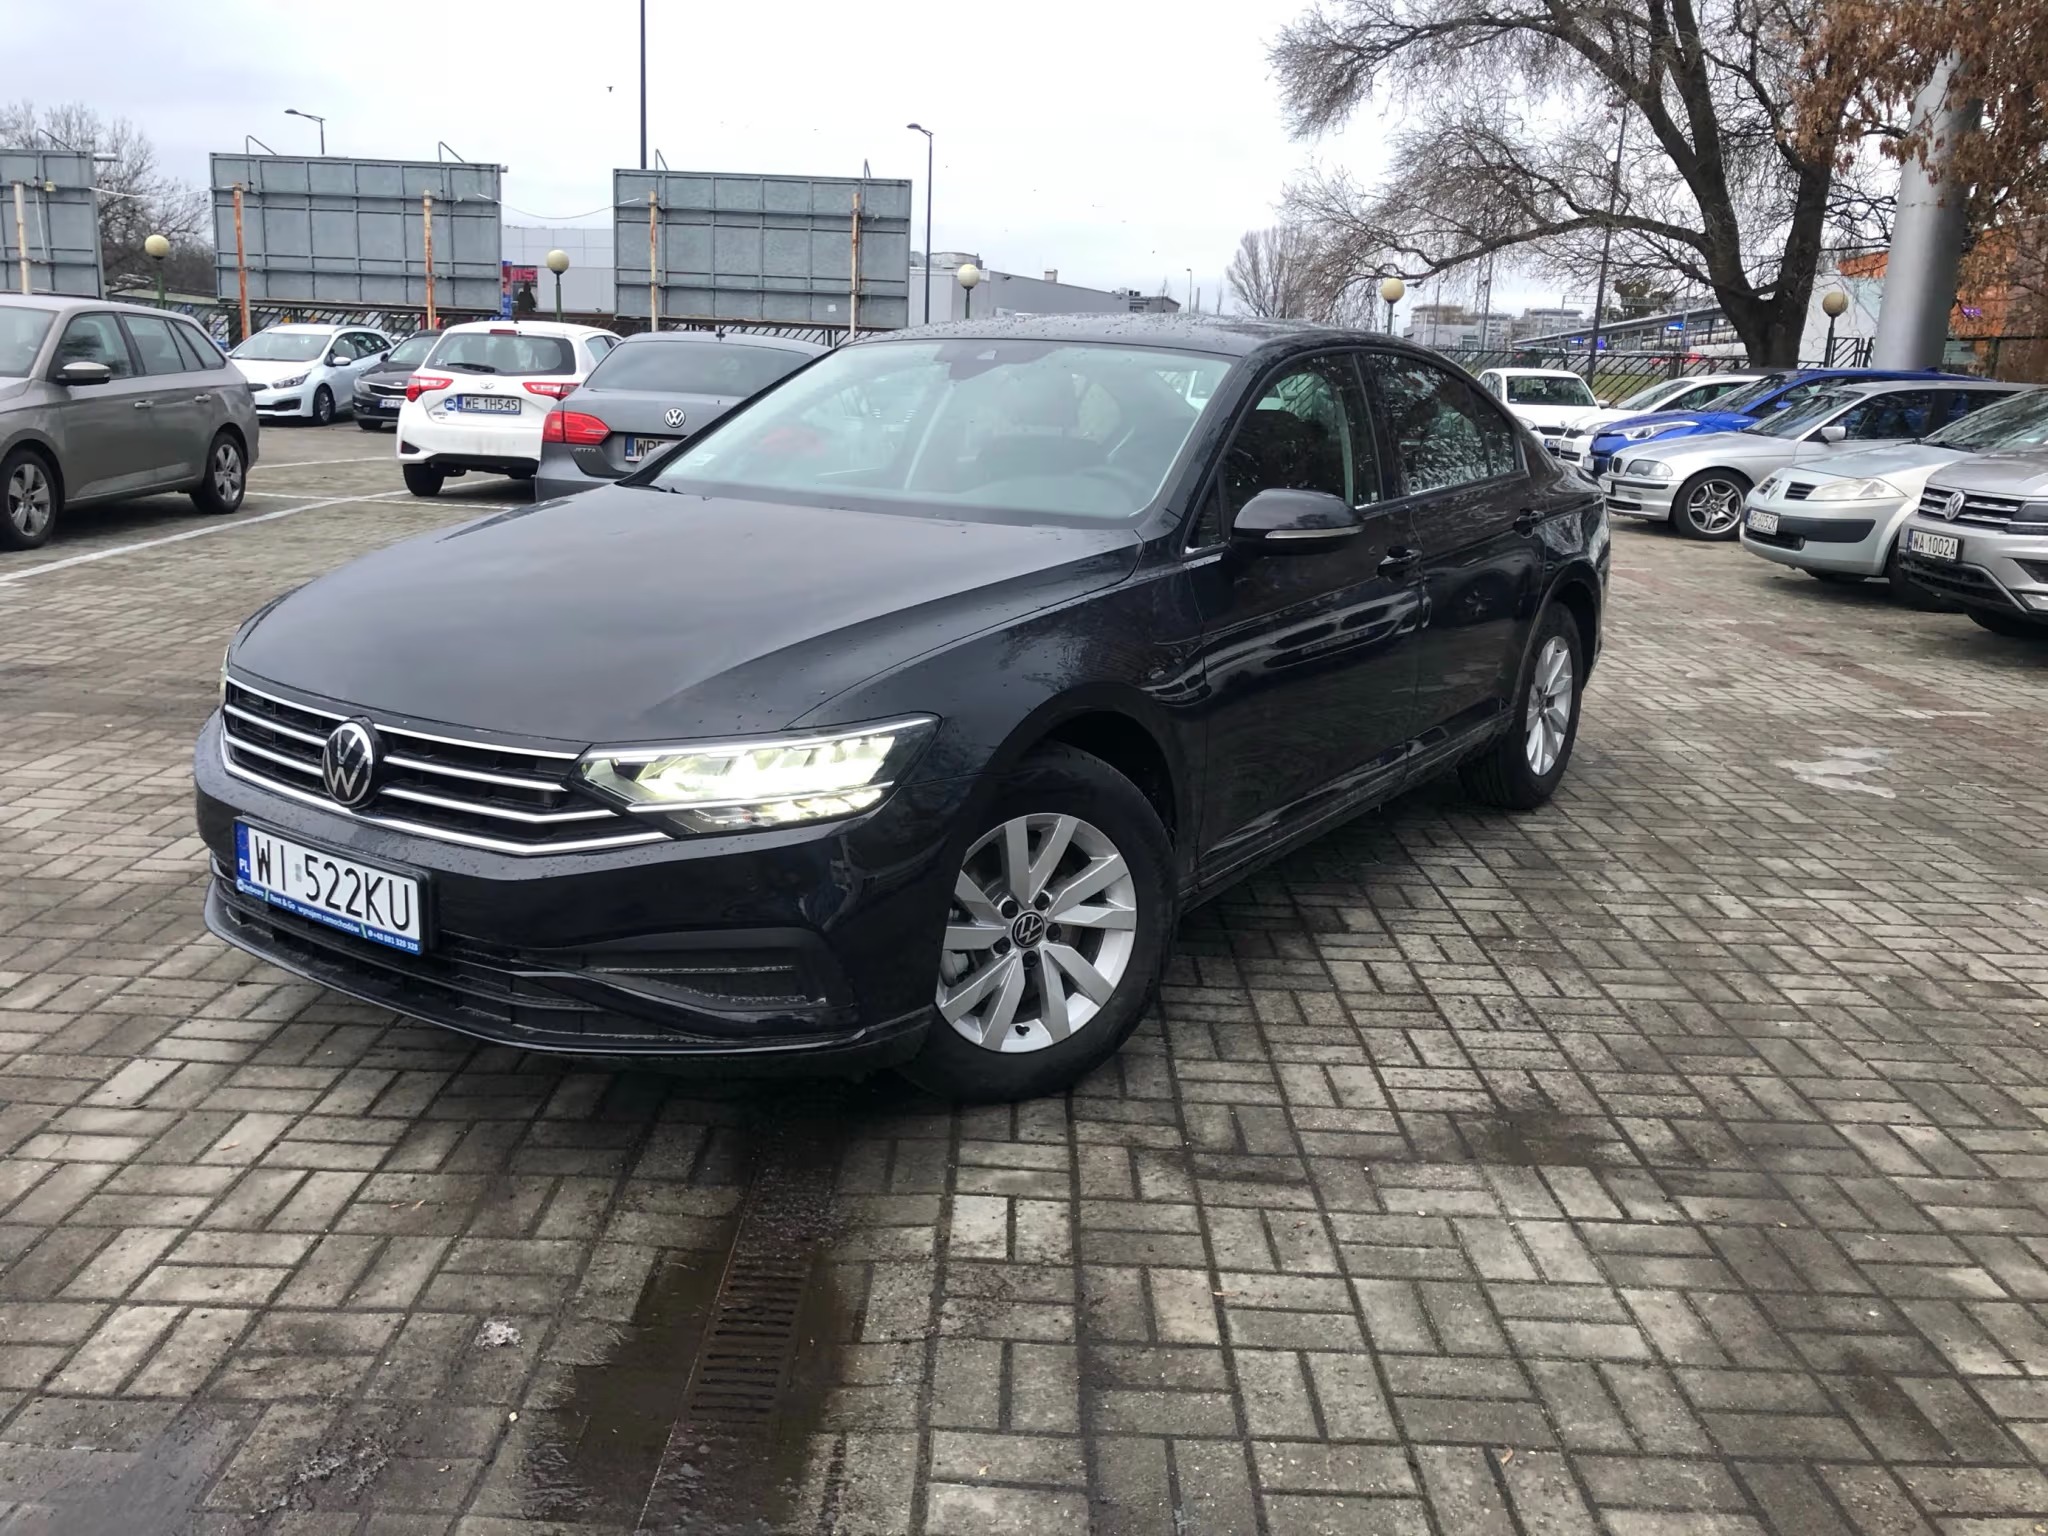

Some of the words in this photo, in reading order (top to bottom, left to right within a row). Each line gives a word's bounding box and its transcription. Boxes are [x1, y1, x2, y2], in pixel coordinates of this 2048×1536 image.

[465, 398, 479, 409] WE
[484, 399, 517, 411] 1H545
[1913, 532, 1925, 552] WA
[1928, 536, 1956, 557] 1002A
[239, 858, 250, 873] PL
[255, 835, 286, 891] WI
[305, 853, 410, 931] 522KU
